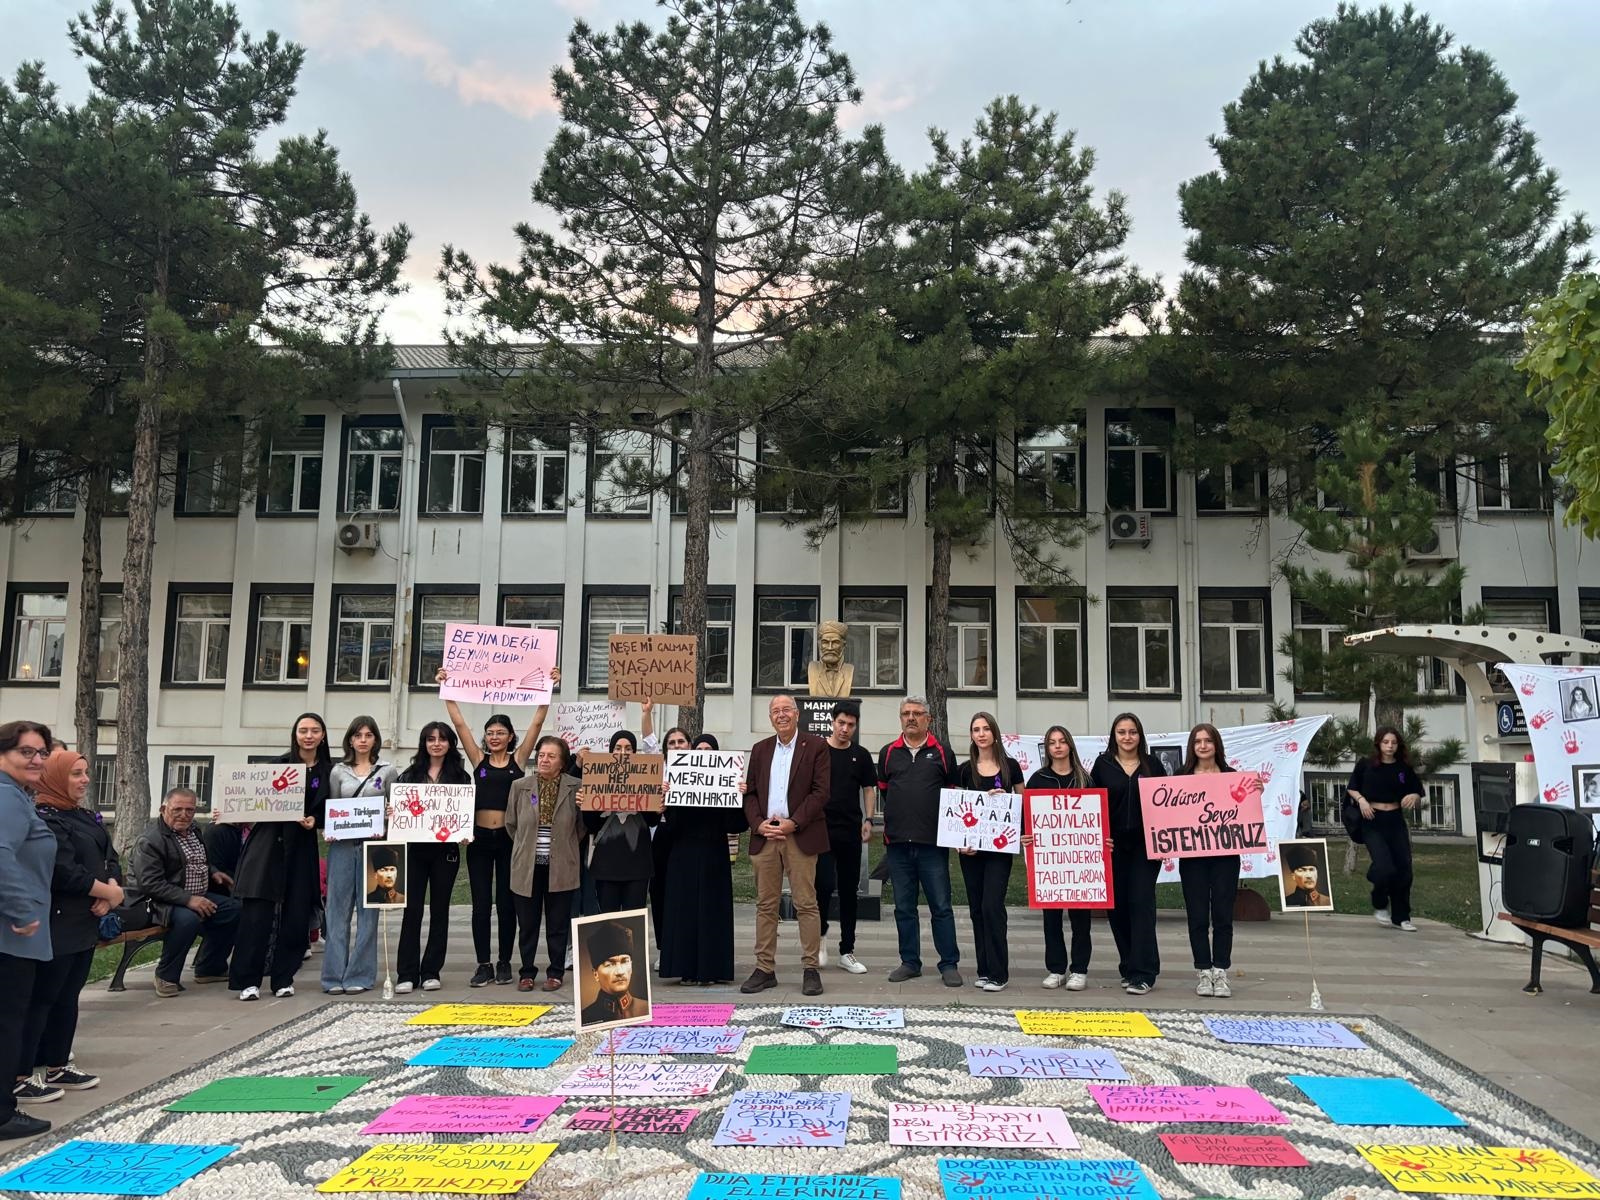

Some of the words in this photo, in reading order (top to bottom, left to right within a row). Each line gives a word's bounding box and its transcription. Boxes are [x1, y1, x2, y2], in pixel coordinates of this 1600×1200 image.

[501, 634, 541, 651] DEĞİL
[446, 660, 471, 672] BEN
[617, 658, 694, 676] YAŞAMAK
[615, 677, 694, 699] İSTİYORUM
[804, 702, 837, 710] MAHM
[813, 712, 833, 721] ESA
[808, 723, 834, 731] EFEN
[608, 773, 629, 783] HEP
[668, 772, 714, 786] MEŞRU
[224, 786, 246, 795] DAHA
[1152, 783, 1206, 807] Öldüren
[445, 798, 460, 812] BU
[591, 794, 649, 811] ÖLECEK!
[1199, 802, 1239, 826] Sevgi
[1032, 812, 1100, 829] KADINLARI
[1034, 833, 1046, 847] EL
[1151, 822, 1267, 854] İSTEMİYORUZ
[1036, 869, 1106, 885] TABUTLARDAN
[970, 1048, 1025, 1058] HAK
[1020, 1058, 1114, 1069] HUKUK
[979, 1066, 1103, 1077] ADALET
[805, 1093, 843, 1101] SES
[894, 1104, 979, 1113] ADALET
[957, 1112, 1042, 1122] SARAYI
[653, 1122, 684, 1131] VAR
[941, 1123, 1023, 1132] ADALET
[1168, 1136, 1227, 1144] KADIN
[453, 1144, 535, 1156] SOLDA
[1359, 1144, 1497, 1157] KADININ
[366, 1154, 437, 1162] ARAMA
[432, 1158, 536, 1171] SORUMLU
[705, 1174, 750, 1185] DUA
[966, 1171, 1111, 1183] TARAFINDAN
[1384, 1168, 1491, 1185] KADINA
[727, 1186, 889, 1199] ELLERİNİZLE
[953, 1182, 1142, 1196] ÖLDÜRÜLÜYORUZ
